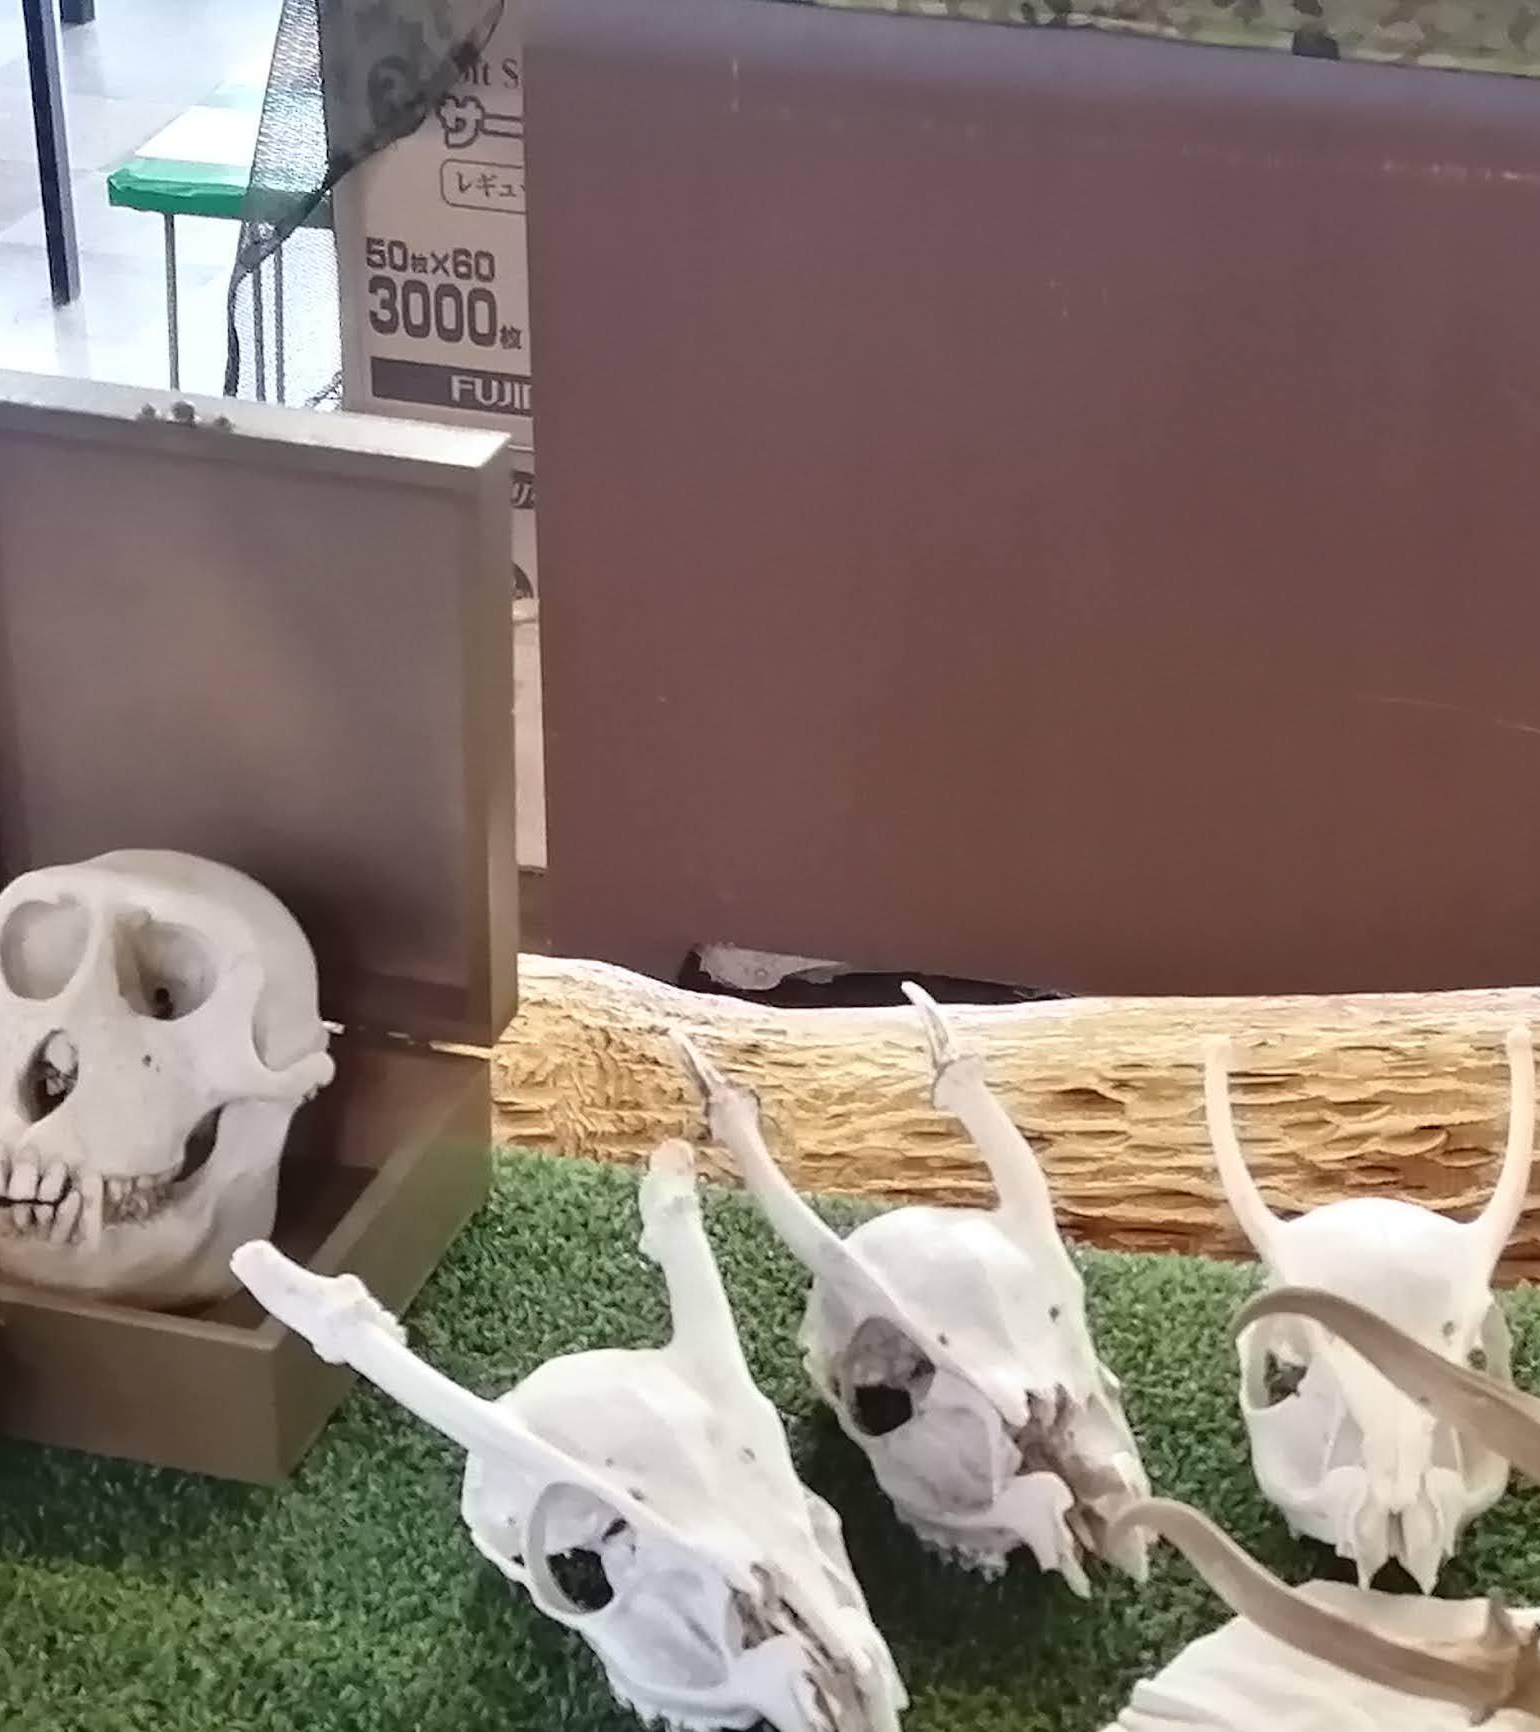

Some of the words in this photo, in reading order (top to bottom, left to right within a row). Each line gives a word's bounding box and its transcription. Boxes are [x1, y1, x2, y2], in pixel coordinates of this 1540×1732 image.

[456, 172, 526, 199] レギュ
[368, 275, 524, 351] 3000枚
